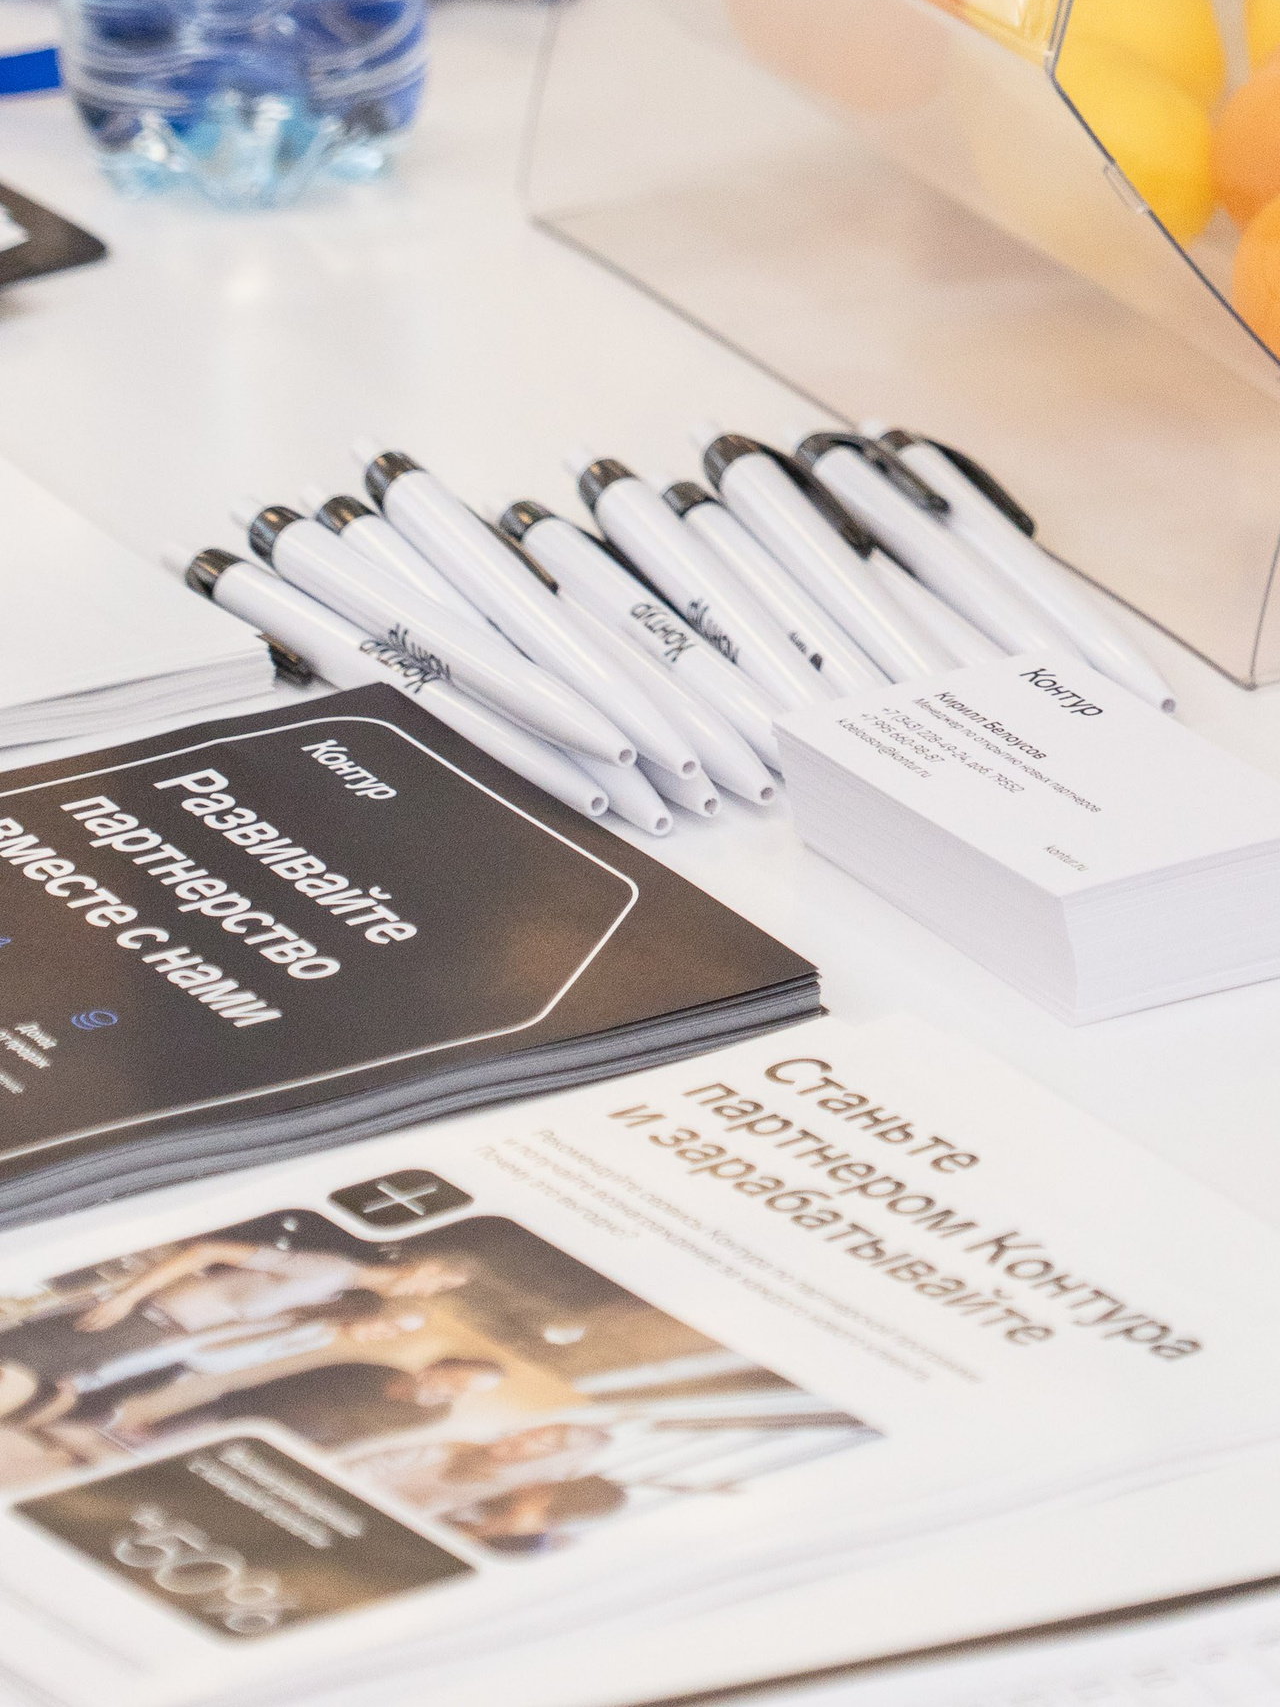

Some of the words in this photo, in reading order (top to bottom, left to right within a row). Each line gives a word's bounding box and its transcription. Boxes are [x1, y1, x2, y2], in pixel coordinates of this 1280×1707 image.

[934, 691, 988, 724] Кирилл
[982, 721, 1048, 761] Белоусов
[1019, 666, 1104, 718] Контур
[301, 739, 397, 800] Контур
[911, 697, 965, 731] Менеджер
[962, 727, 978, 739] по
[974, 736, 1024, 766] открытию
[1020, 762, 1052, 784] новых
[1048, 781, 1102, 813] партнеров
[60, 796, 341, 981] партнерство
[153, 768, 418, 945] Развивайте
[1043, 845, 1089, 873] kontur.ru
[115, 926, 169, 950] с
[141, 946, 283, 1029] нами
[765, 1056, 980, 1175] Станьте
[607, 1103, 668, 1129] и
[649, 1127, 1056, 1348] зарабатывайте
[682, 1081, 977, 1239] партнером
[966, 1226, 1204, 1363] Контура
